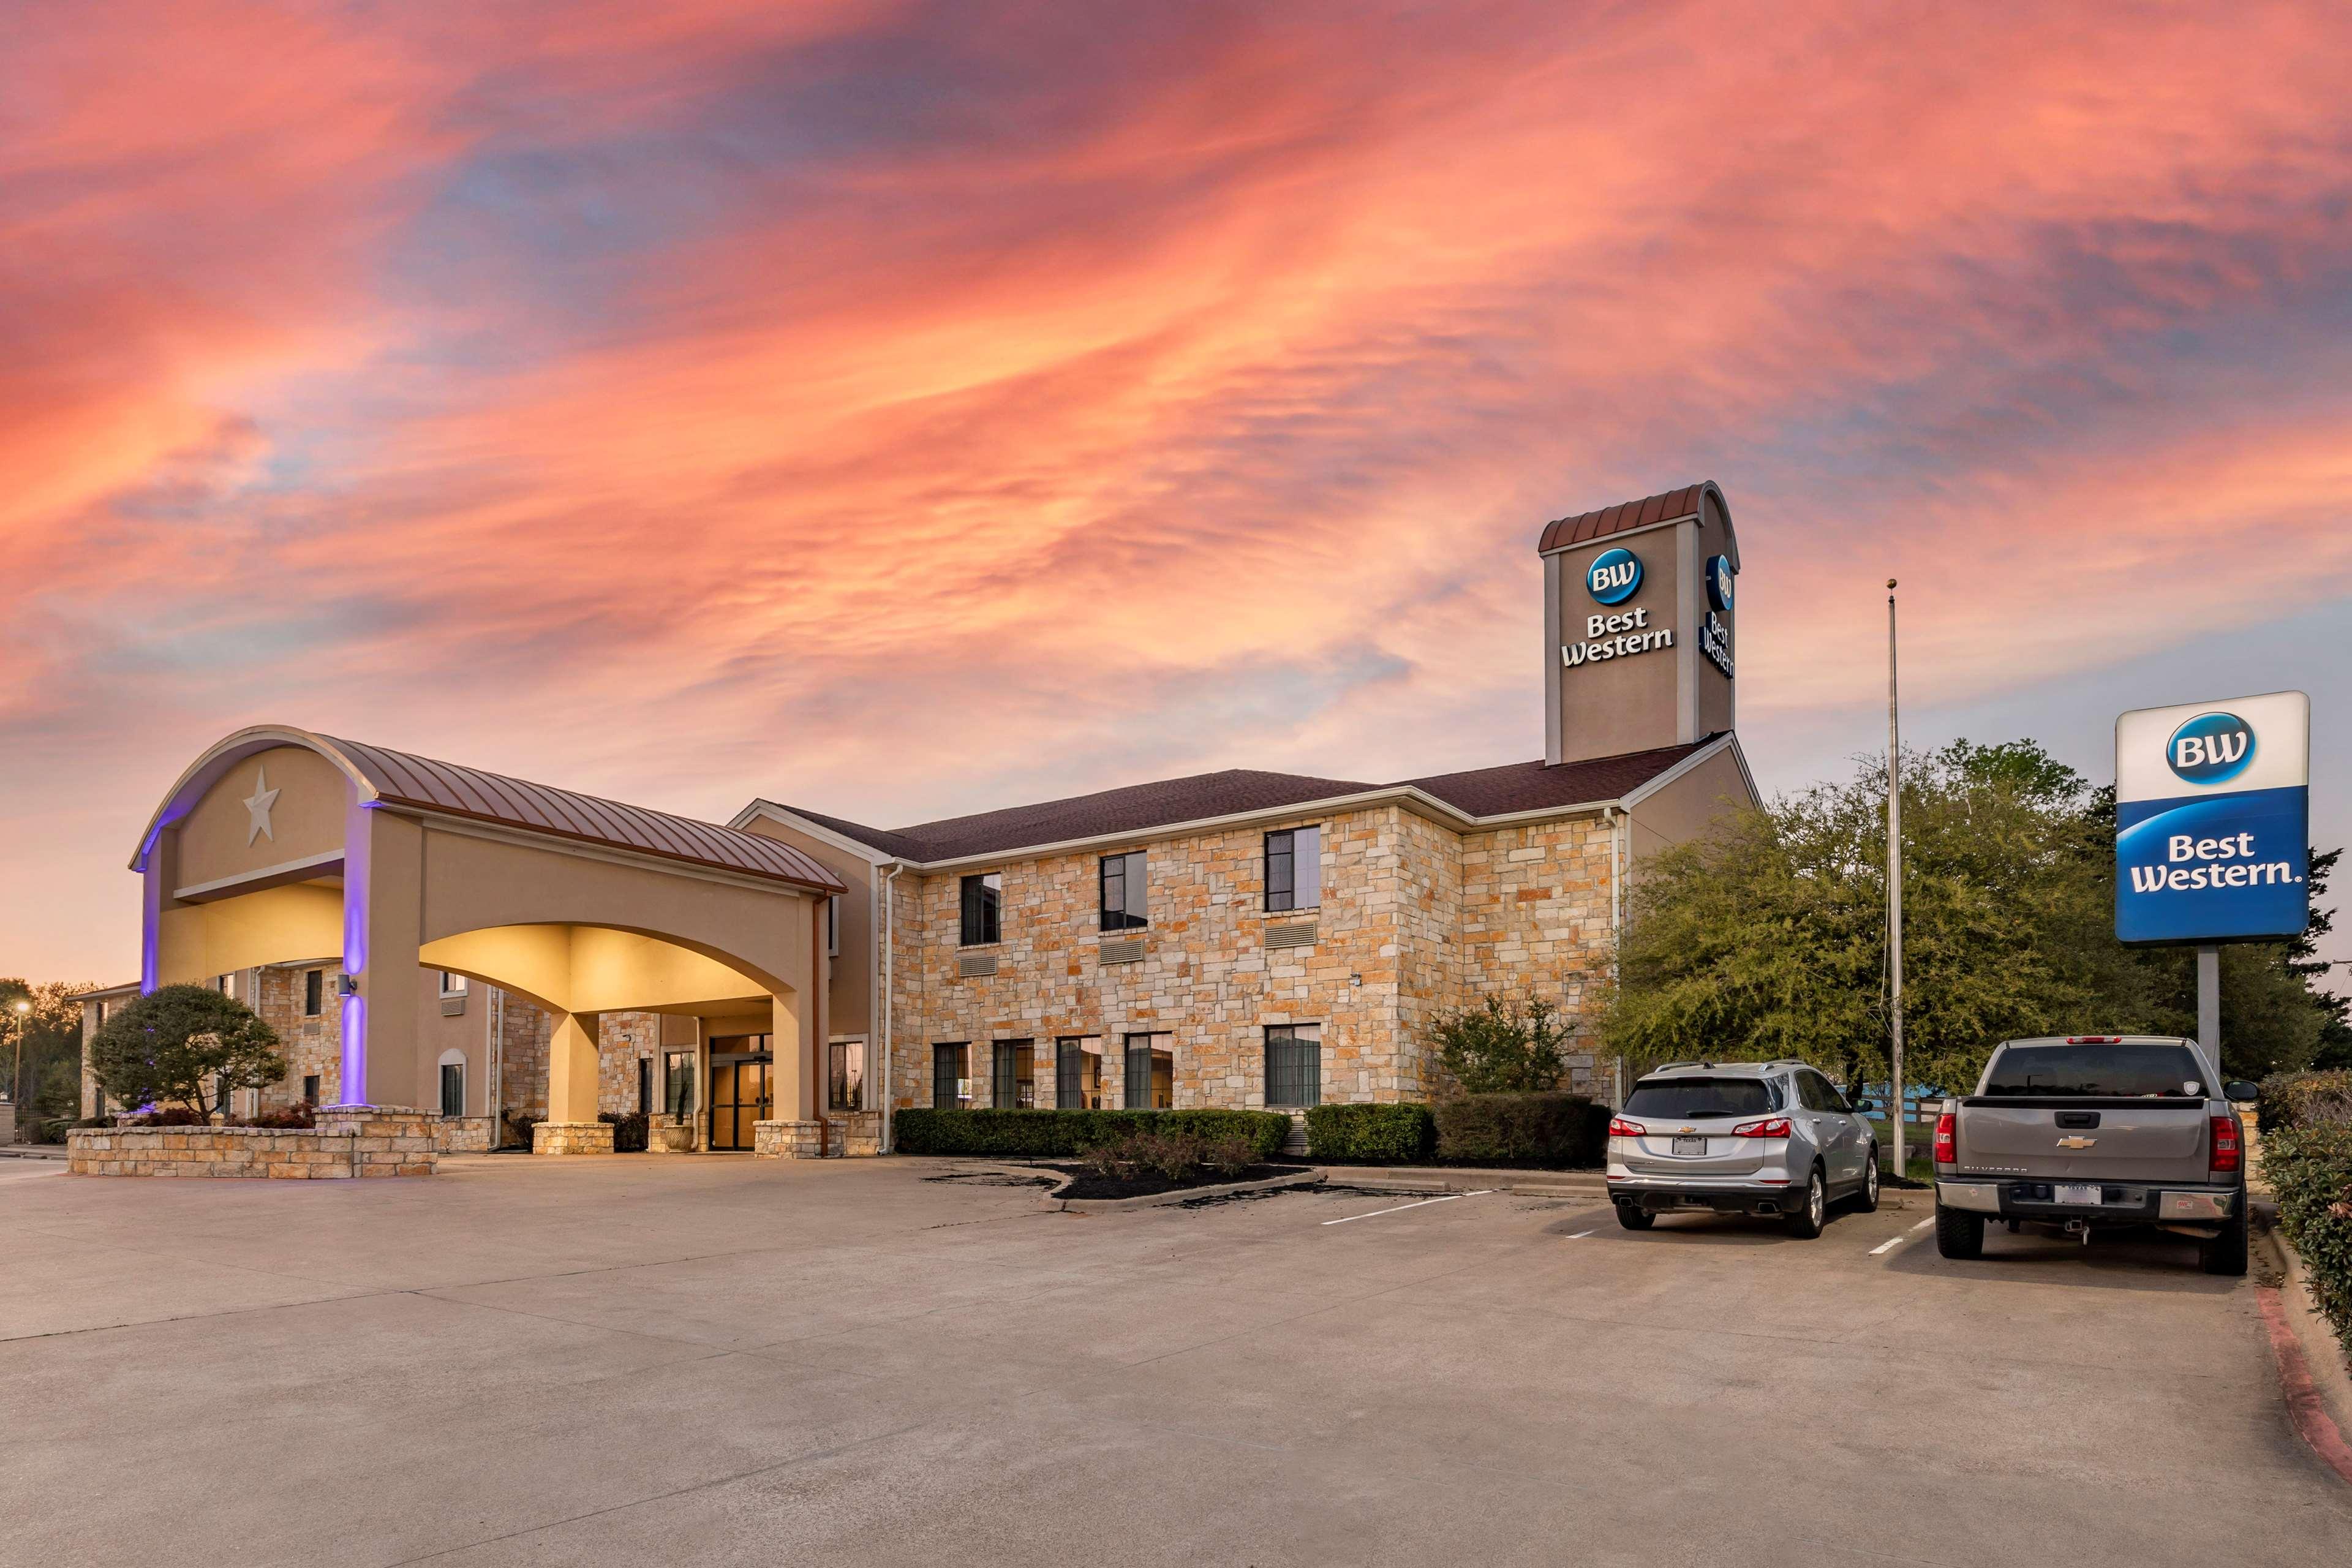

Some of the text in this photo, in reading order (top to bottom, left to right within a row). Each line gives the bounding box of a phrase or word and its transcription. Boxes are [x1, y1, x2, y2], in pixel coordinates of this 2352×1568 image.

[1593, 560, 1635, 592] BW
[1719, 567, 1732, 598] BW
[1587, 607, 1647, 638] Best
[1711, 611, 1728, 648] Best
[1561, 628, 1673, 667] Western
[1704, 626, 1735, 679] Western
[2177, 731, 2247, 767] BW
[2169, 832, 2255, 862] Best
